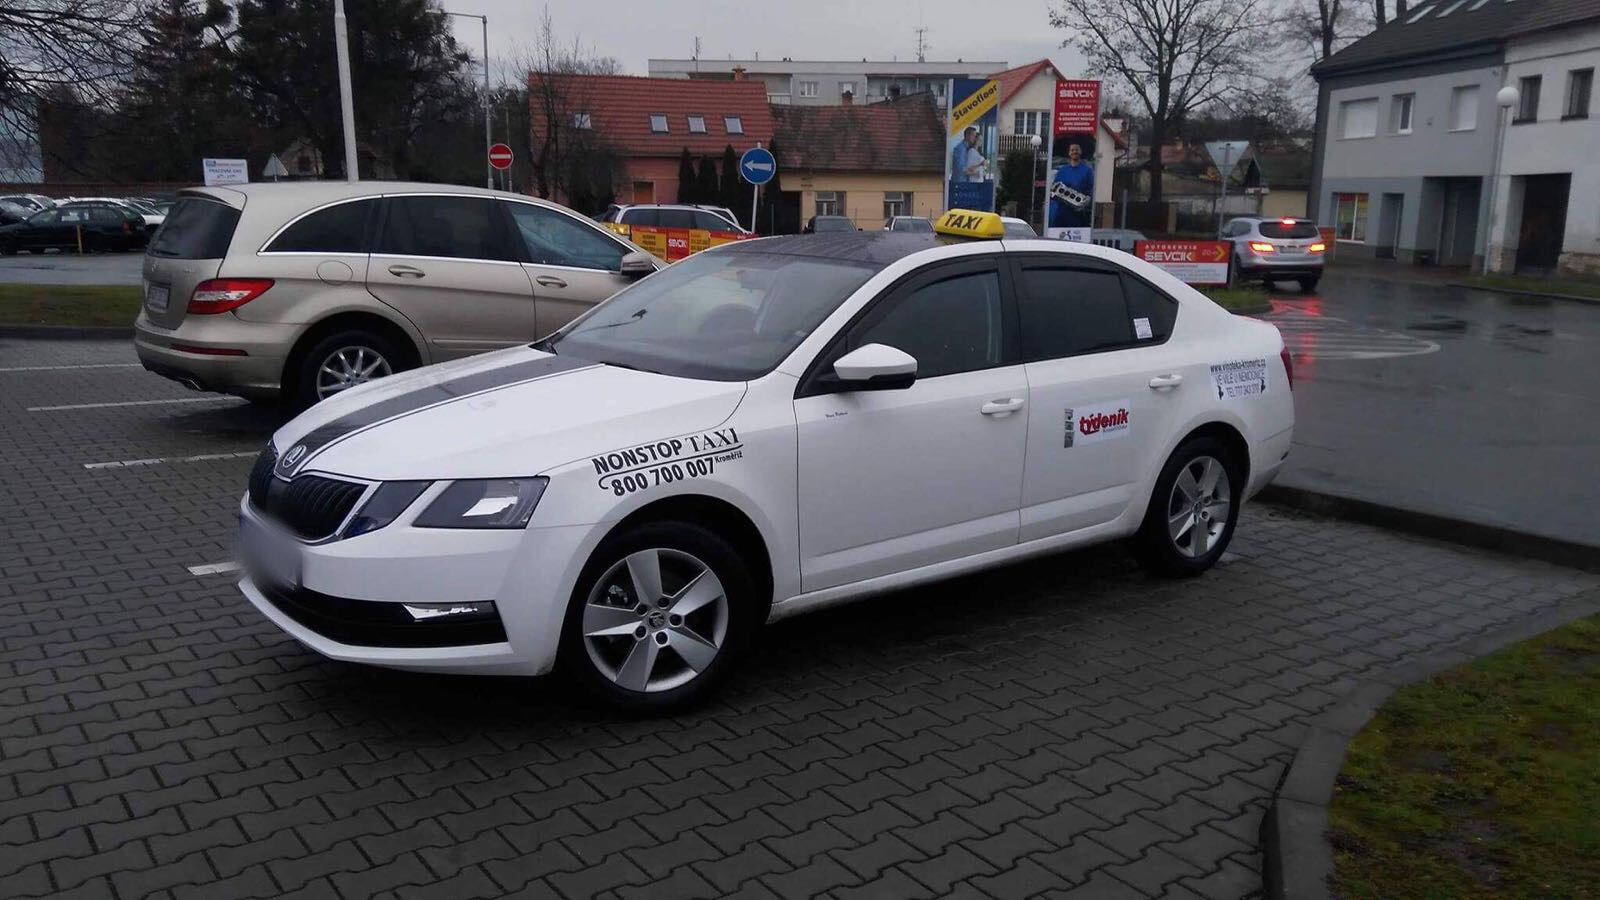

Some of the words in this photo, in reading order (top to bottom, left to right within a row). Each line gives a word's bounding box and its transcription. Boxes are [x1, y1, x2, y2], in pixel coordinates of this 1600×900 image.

[952, 83, 998, 121] Stavofloor
[944, 214, 984, 231] TAXI
[1079, 408, 1130, 435] týdeník
[591, 438, 683, 475] NONSTOP
[685, 427, 740, 453] TAXI
[714, 450, 744, 464] Kroměříž
[611, 472, 648, 497] 800
[649, 464, 684, 486] 700
[685, 457, 715, 478] 007
